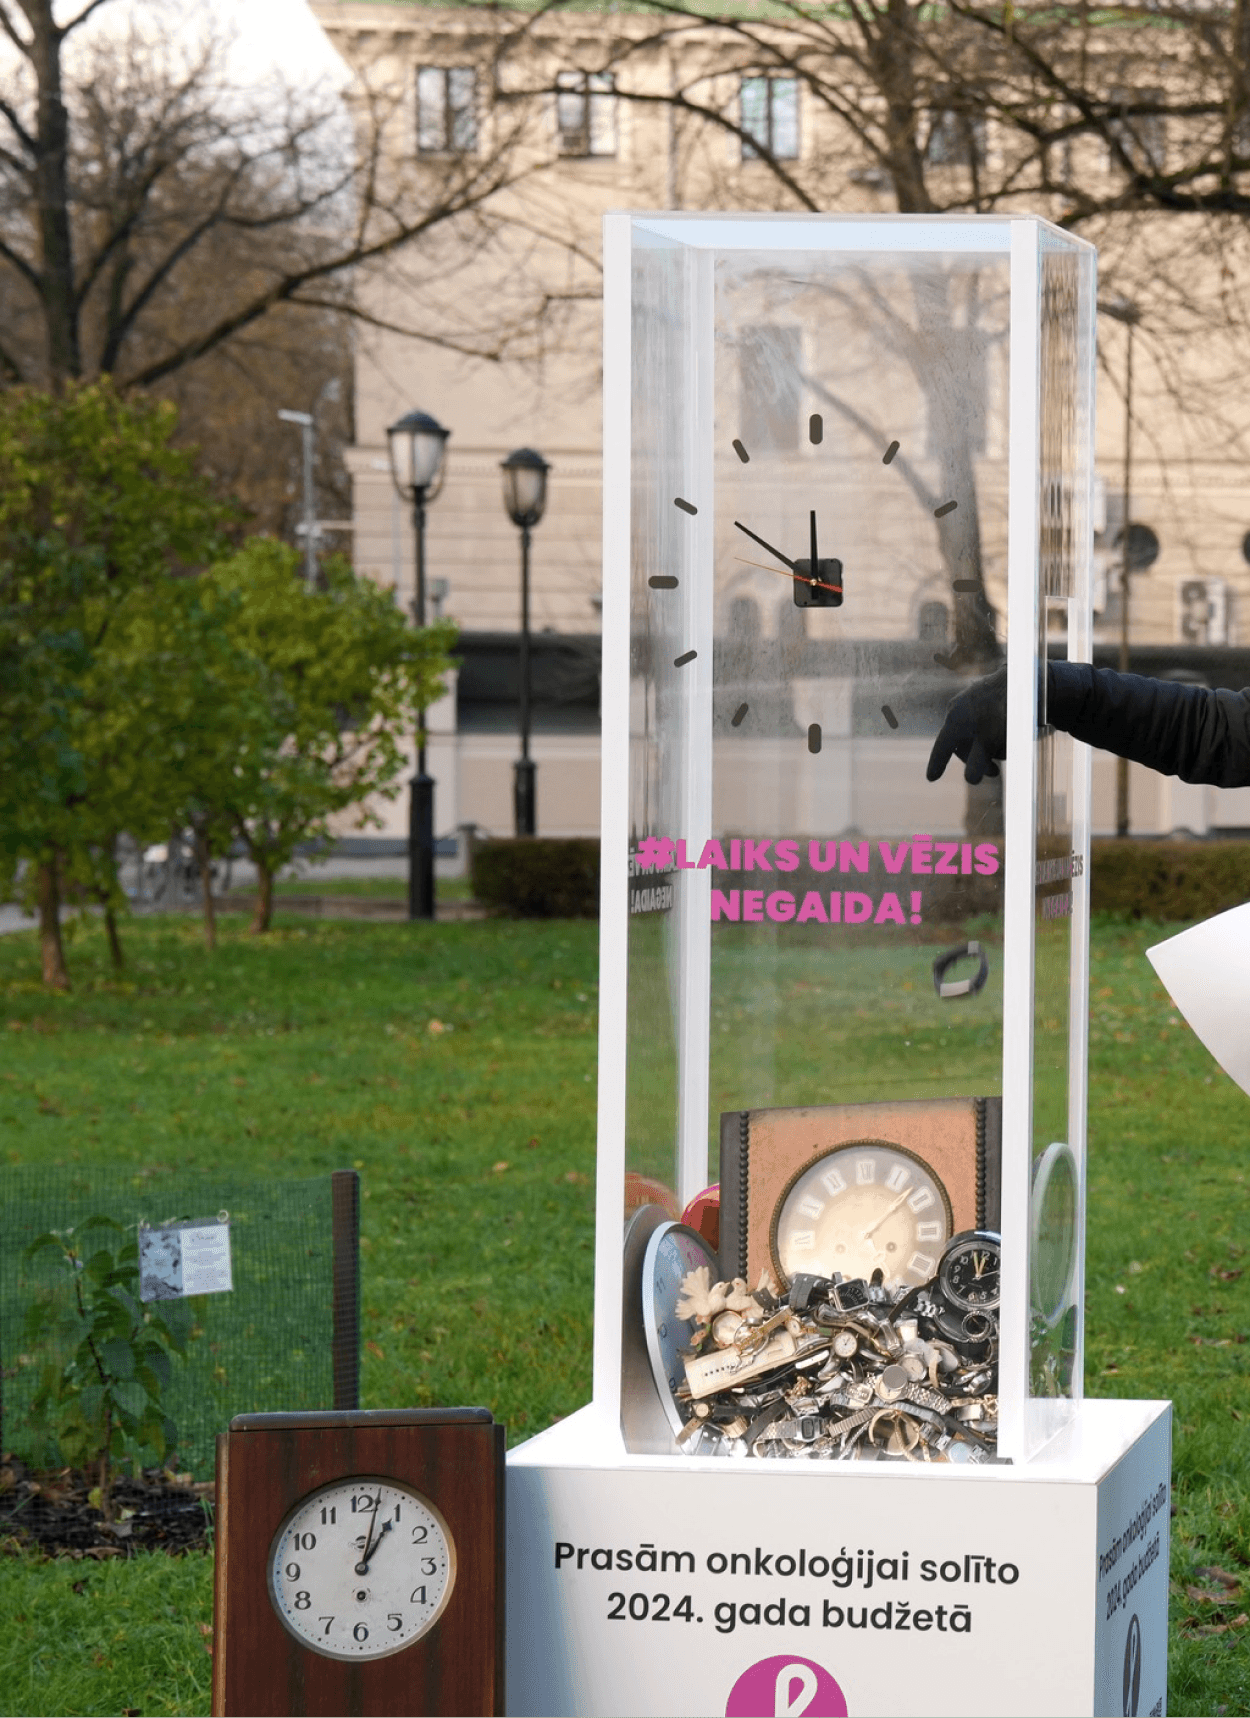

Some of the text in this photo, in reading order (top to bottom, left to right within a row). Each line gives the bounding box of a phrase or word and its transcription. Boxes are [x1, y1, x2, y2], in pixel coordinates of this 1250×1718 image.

[635, 835, 800, 872] #LAIKS
[808, 839, 870, 873] UN
[877, 833, 999, 875] VĒZIS
[710, 889, 922, 925] NEGAIDA!
[351, 1495, 376, 1513] 12
[394, 1503, 401, 1522] 1
[320, 1506, 336, 1525] 11
[293, 1532, 317, 1551] 10
[411, 1526, 428, 1545] 2
[285, 1562, 301, 1582] 9
[420, 1557, 437, 1576] 3
[554, 1541, 1020, 1589] Prasām onkoloģijai solīto
[294, 1591, 312, 1610] 8
[410, 1585, 427, 1605] 4
[607, 1591, 972, 1634] 2024. gada budžetā
[318, 1616, 335, 1635] 7
[353, 1622, 369, 1642] 6
[386, 1613, 403, 1632] 5
